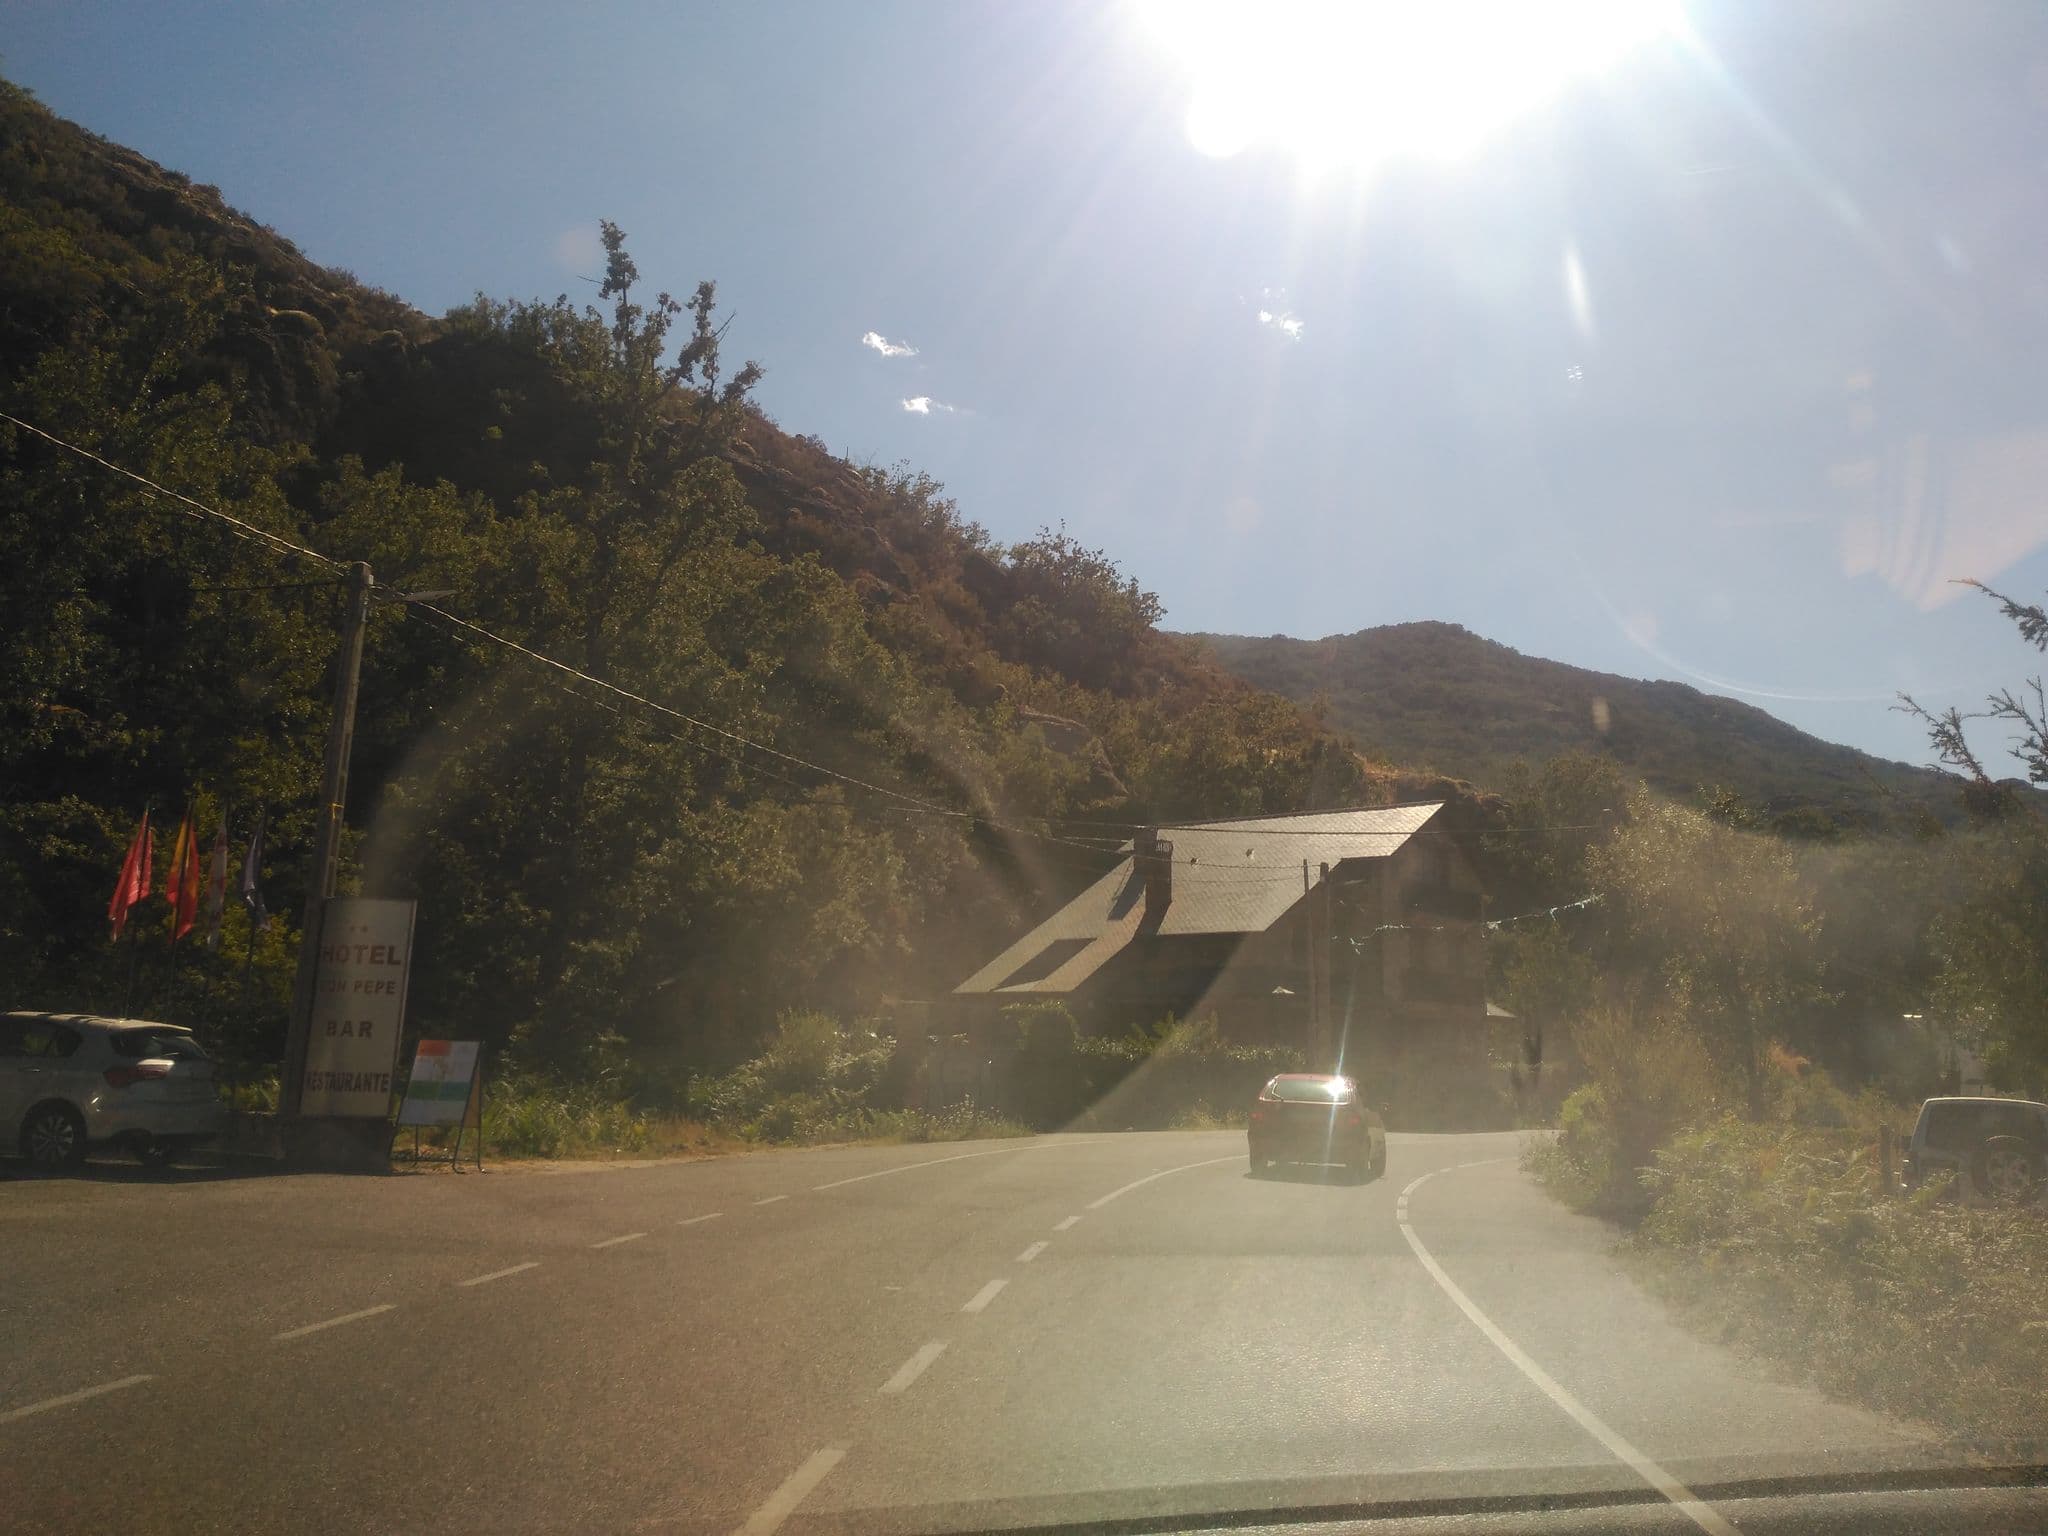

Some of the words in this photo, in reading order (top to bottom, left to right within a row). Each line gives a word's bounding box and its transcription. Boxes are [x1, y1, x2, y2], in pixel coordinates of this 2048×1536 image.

[320, 944, 402, 966] HOTEL
[319, 979, 347, 994] ON
[353, 979, 397, 995] PEPE
[326, 1020, 373, 1038] BAR
